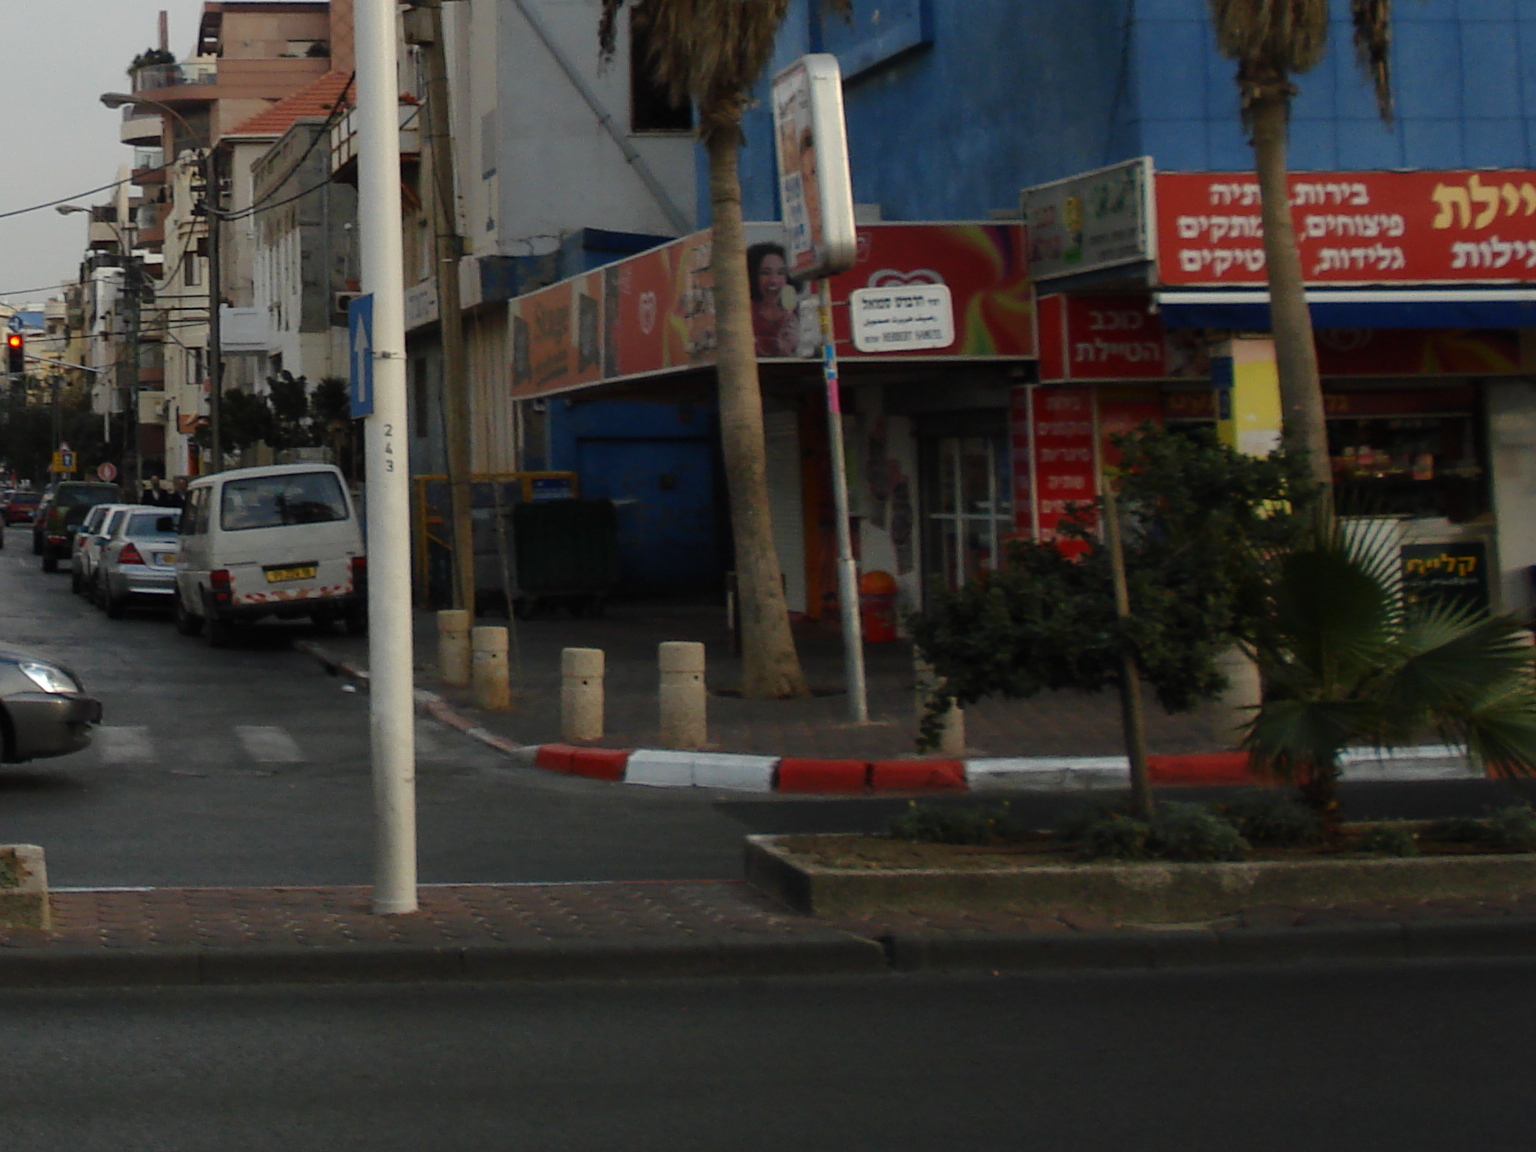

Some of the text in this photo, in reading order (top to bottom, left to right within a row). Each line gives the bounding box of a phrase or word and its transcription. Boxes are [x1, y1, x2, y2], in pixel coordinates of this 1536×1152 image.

[1208, 183, 1370, 207] בירות, תיה
[1176, 214, 1405, 243] פיצוחים, מתקים
[1179, 242, 1405, 277] גלידות, טיקים
[1075, 337, 1160, 362] הטיילת
